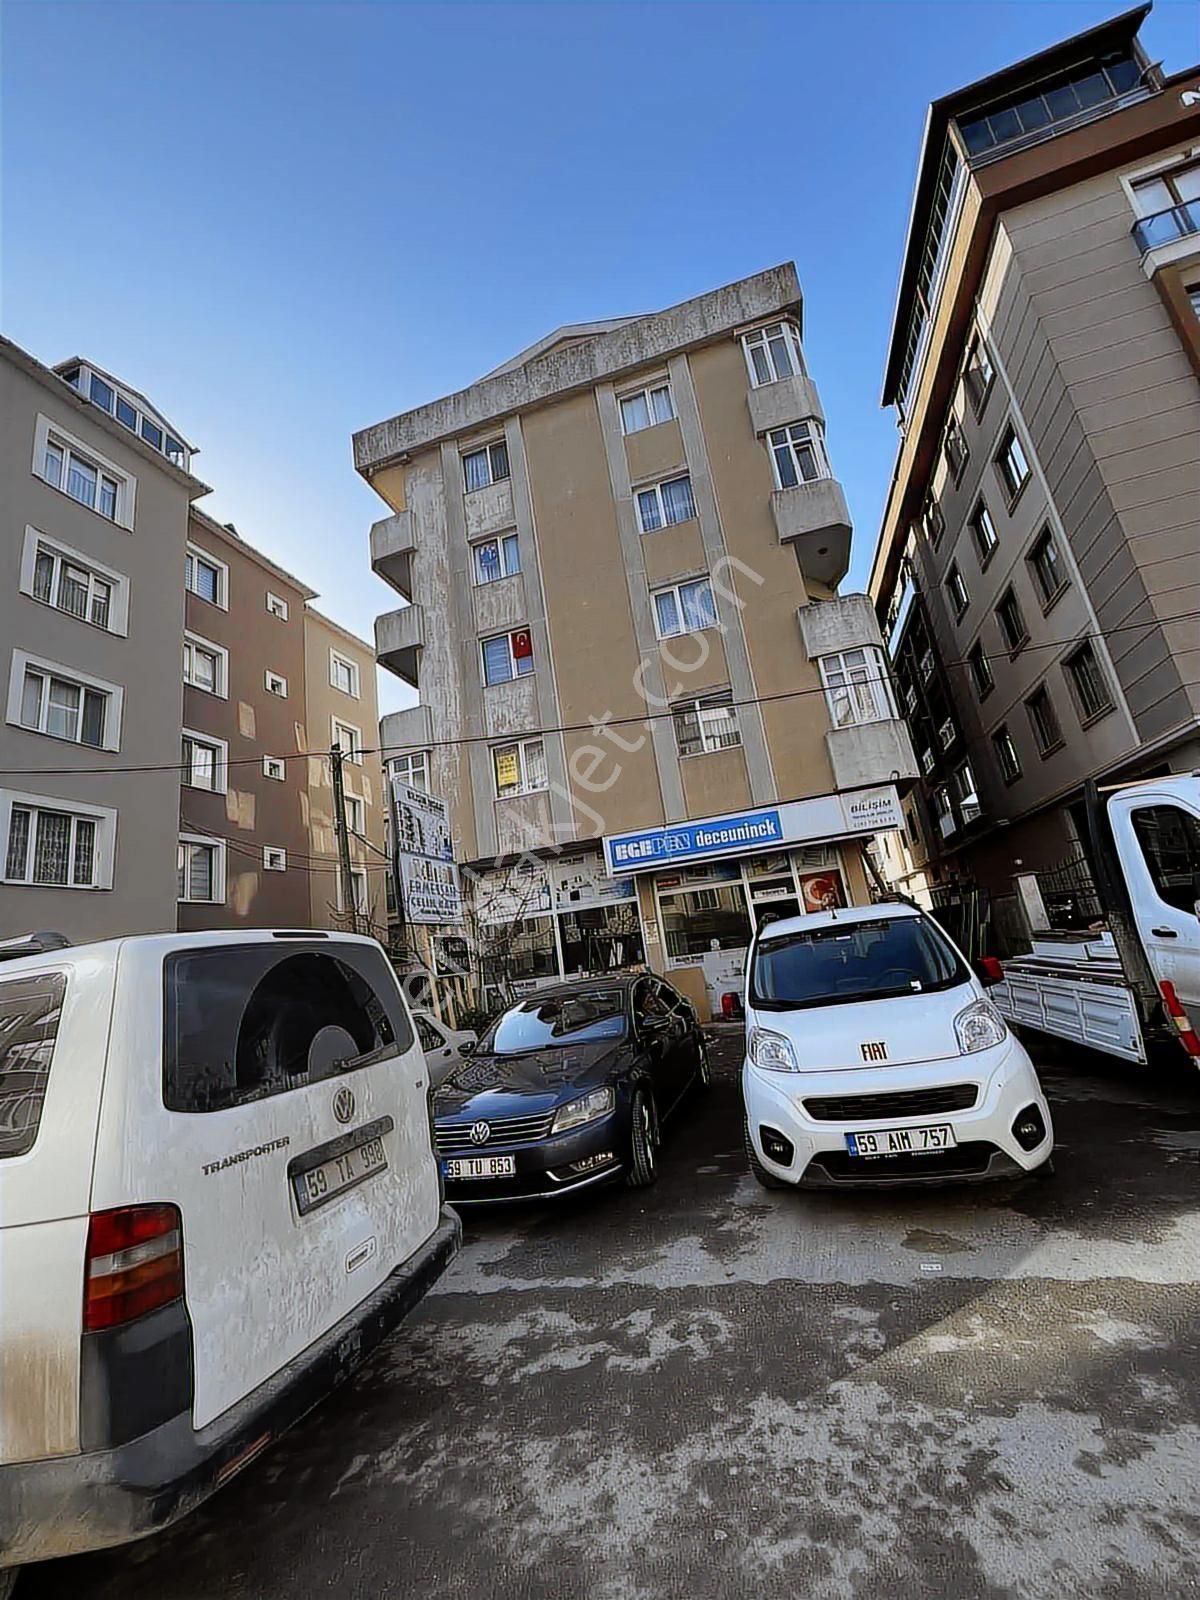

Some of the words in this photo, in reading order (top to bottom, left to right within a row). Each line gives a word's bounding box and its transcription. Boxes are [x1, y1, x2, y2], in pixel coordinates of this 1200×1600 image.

[695, 819, 776, 847] deceuninck
[860, 1042, 887, 1061] FIAT
[857, 1135, 878, 1153] 59
[919, 1128, 947, 1148] 757
[201, 1136, 290, 1176] TRANSPORTER
[306, 1169, 328, 1197] 59
[336, 1156, 354, 1182] TA
[361, 1141, 383, 1169] 998
[447, 1161, 461, 1176] 59
[468, 1160, 482, 1175] TU
